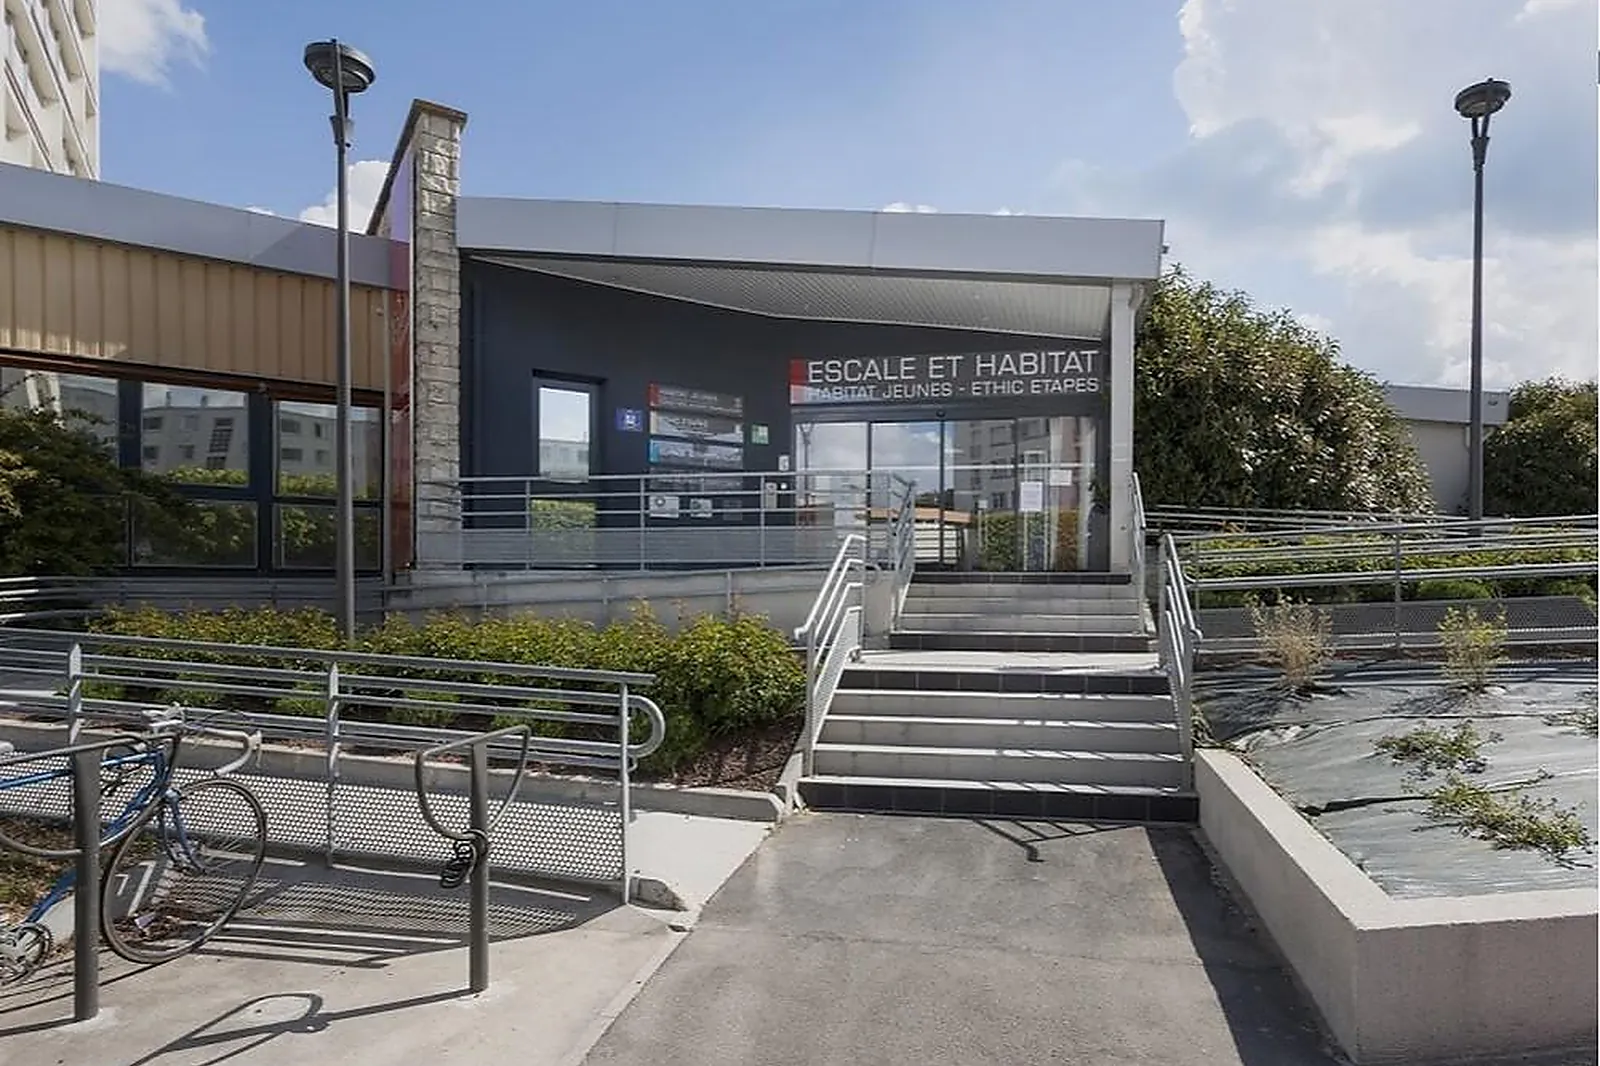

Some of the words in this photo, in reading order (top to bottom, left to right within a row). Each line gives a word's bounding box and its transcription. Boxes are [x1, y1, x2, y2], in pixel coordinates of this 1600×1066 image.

[807, 356, 917, 383] ESCALE
[928, 355, 964, 379] ET
[975, 350, 1099, 377] HABITAT
[882, 383, 952, 399] JEUNES
[971, 380, 1024, 396] ETHIC
[1030, 378, 1099, 394] ETAPES
